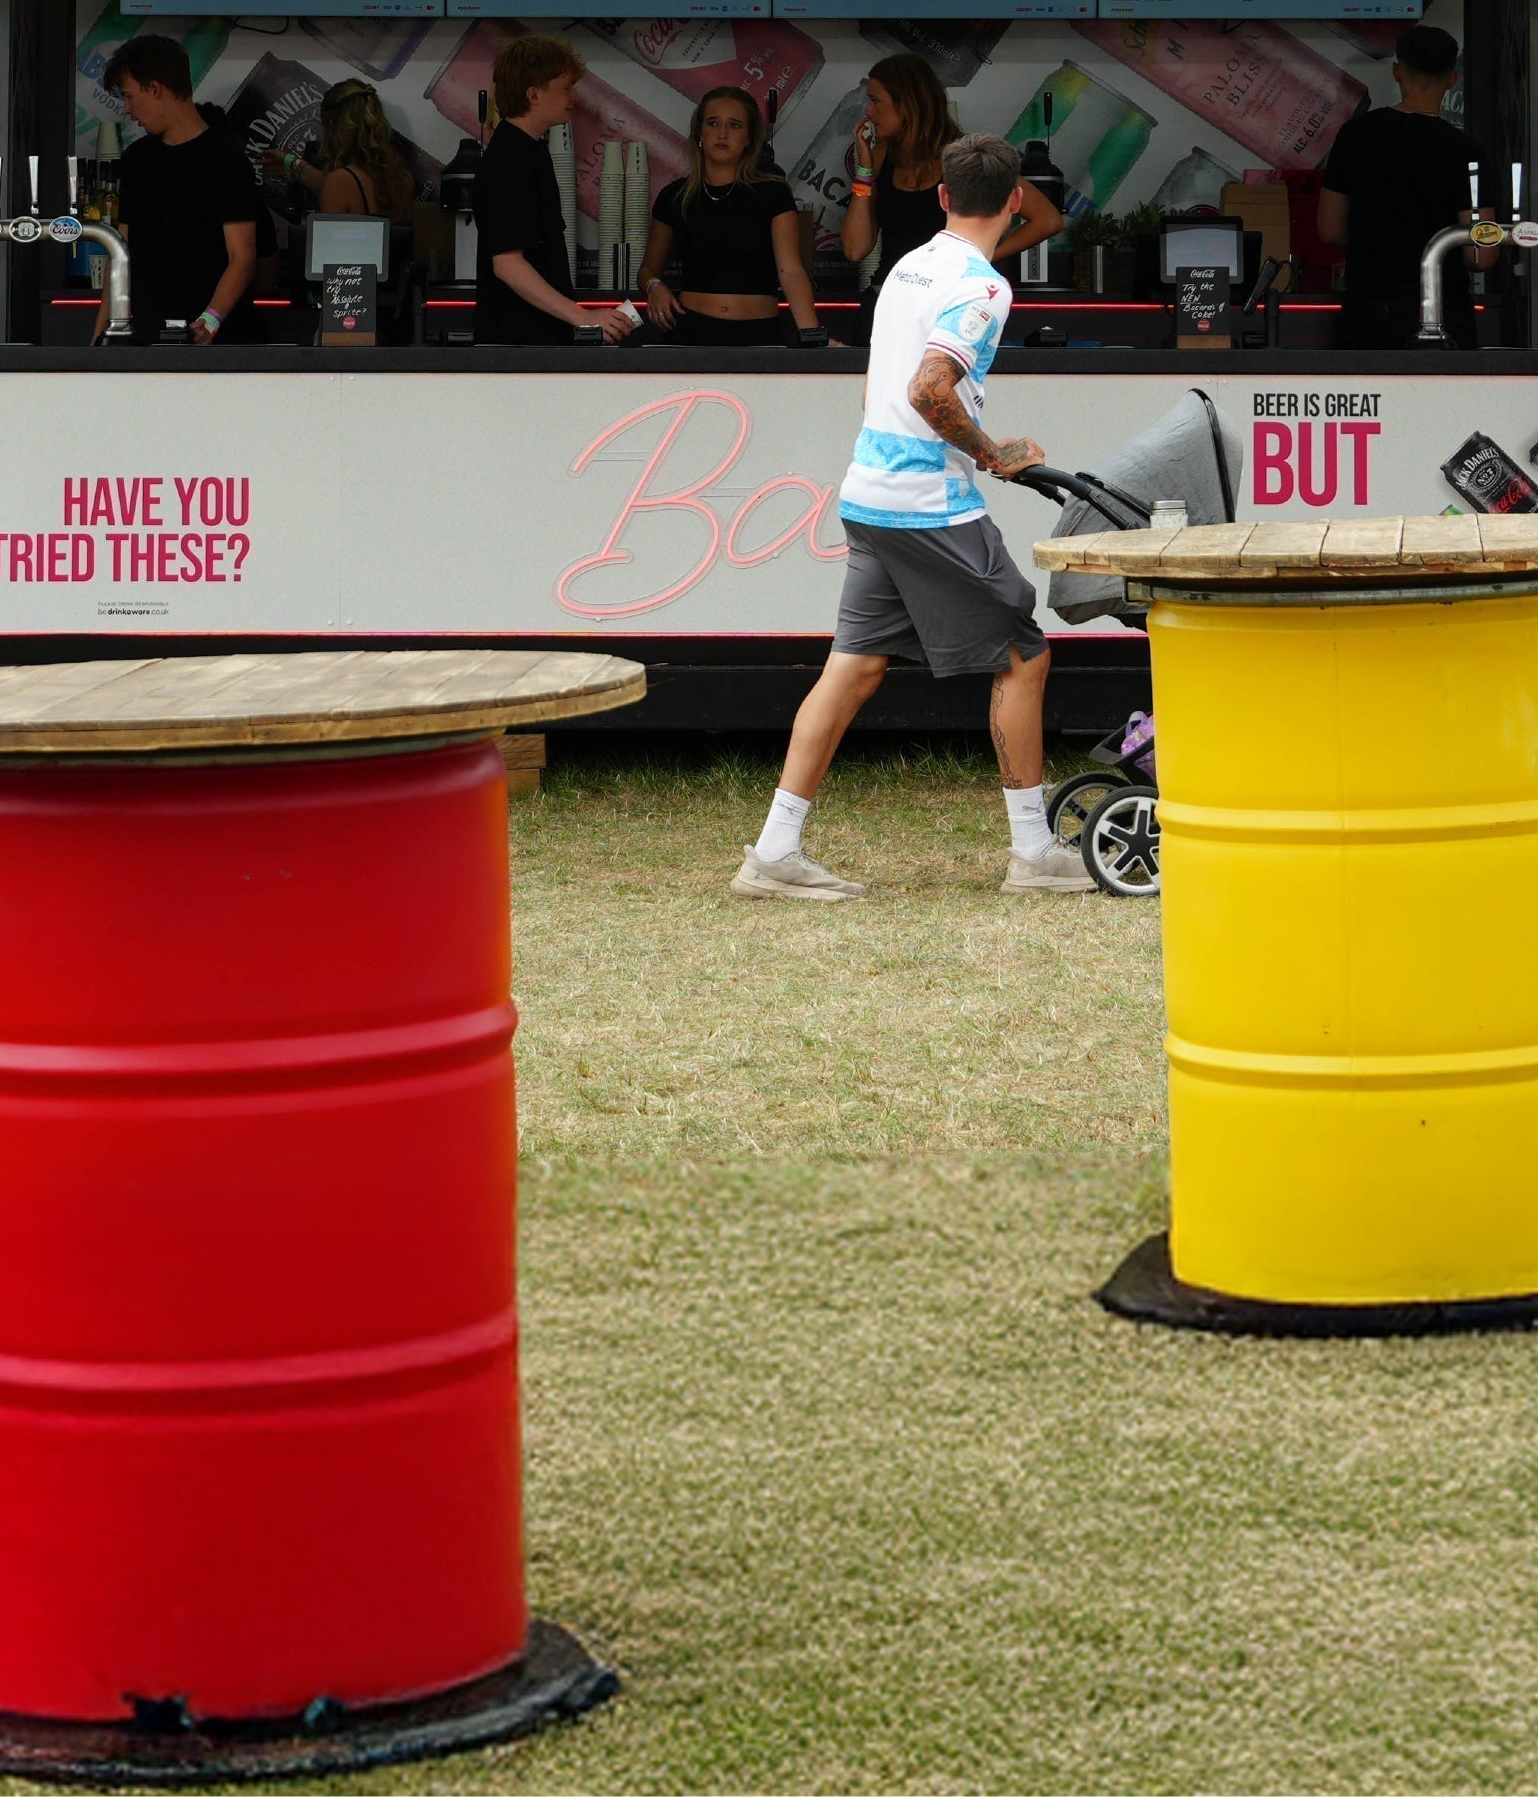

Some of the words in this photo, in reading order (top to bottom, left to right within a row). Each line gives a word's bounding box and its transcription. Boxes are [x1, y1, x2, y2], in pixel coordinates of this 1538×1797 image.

[1203, 33, 1260, 105] PALOMA
[1227, 50, 1269, 107] BLISS
[92, 89, 127, 118] VODK
[250, 81, 325, 152] DANIEL'S
[574, 115, 626, 187] ALOMA
[798, 159, 855, 209] BACA
[52, 224, 79, 235] Coors
[1182, 283, 1197, 294] Try
[1200, 281, 1215, 291] the
[1253, 393, 1299, 417] BEER
[1304, 393, 1320, 417] IS
[1324, 393, 1381, 417] GREAT
[1253, 422, 1381, 507] BUT
[1454, 463, 1472, 491] JACK
[1463, 445, 1500, 474] DANIEL'S
[63, 477, 164, 526] HAVE
[174, 476, 250, 527] YOU
[105, 532, 251, 583] THESE?
